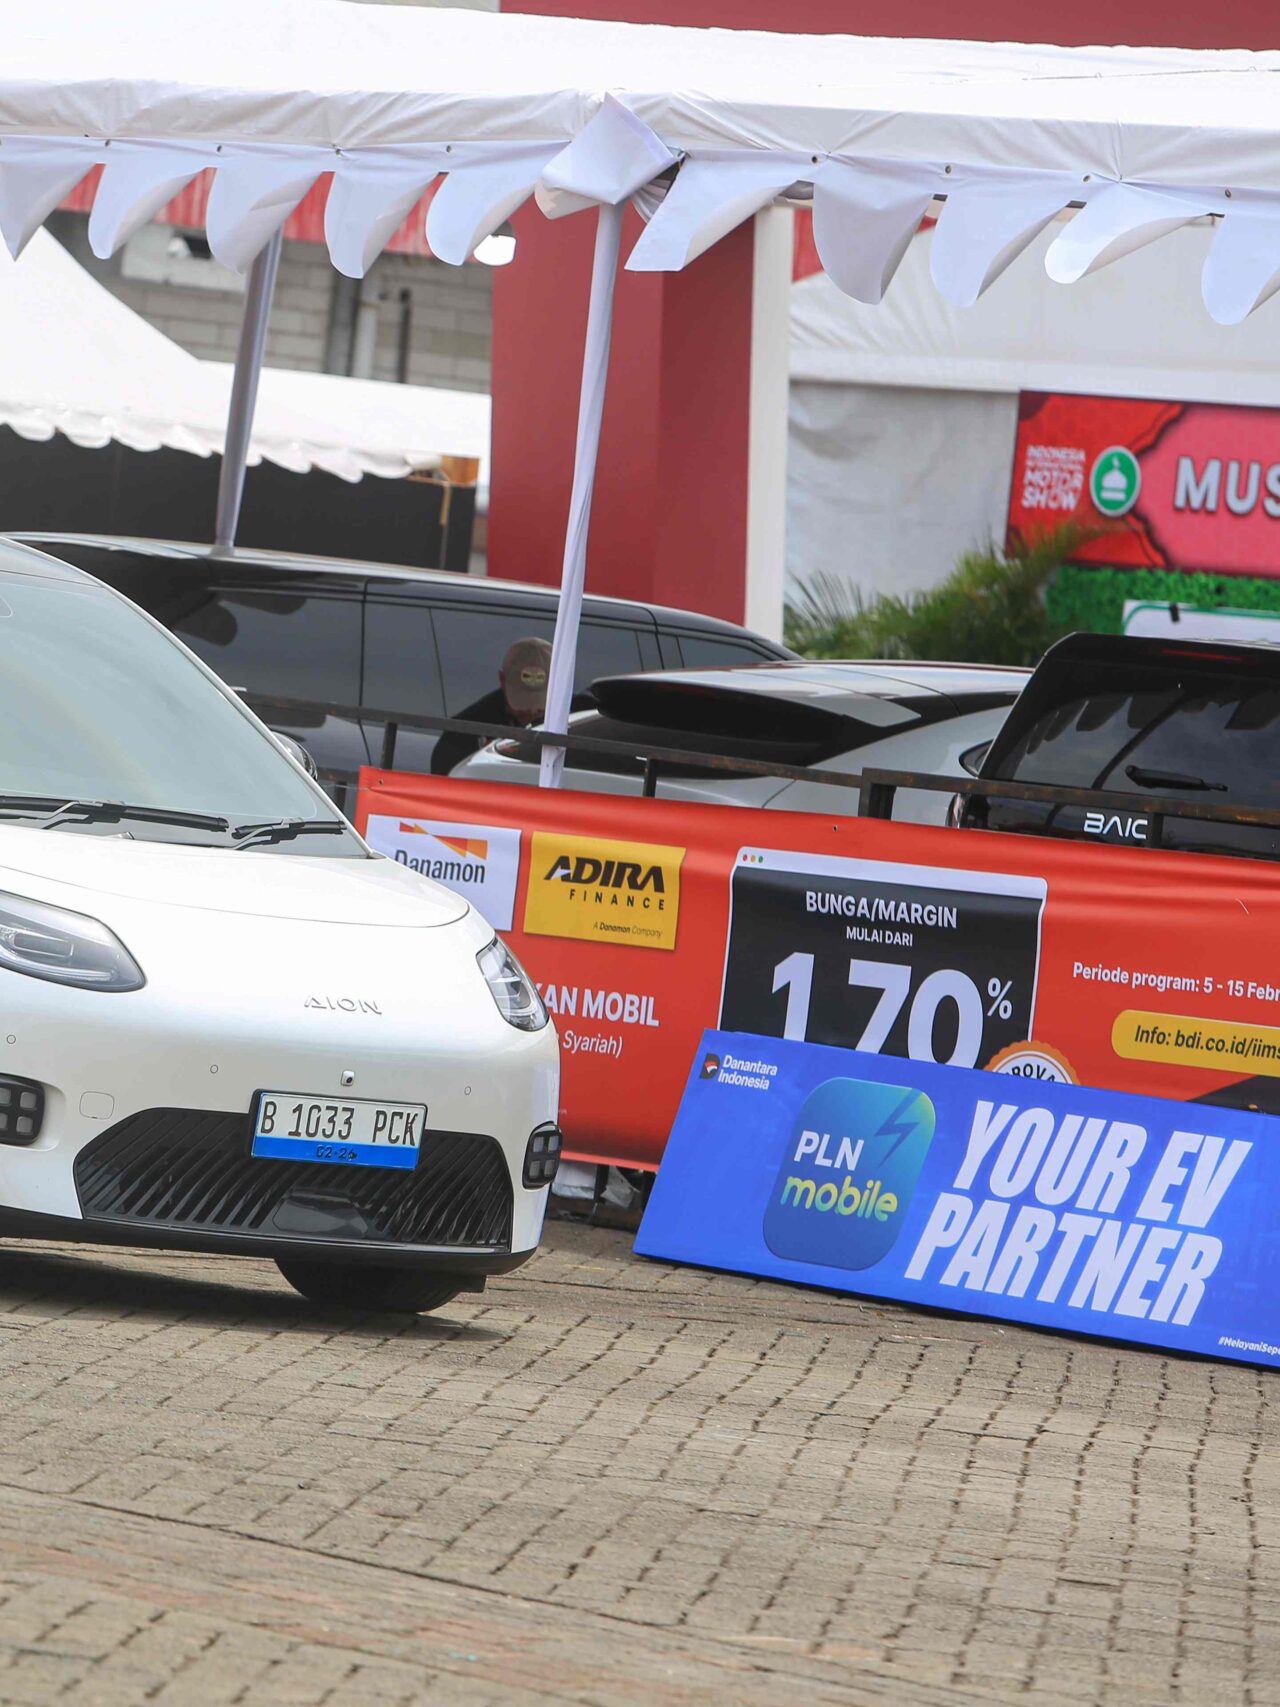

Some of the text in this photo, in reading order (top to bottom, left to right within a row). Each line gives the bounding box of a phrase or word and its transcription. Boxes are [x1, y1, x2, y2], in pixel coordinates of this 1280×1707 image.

[1084, 812, 1148, 839] BAIC
[395, 850, 485, 884] Danamon
[544, 855, 665, 893] ADIRA
[569, 888, 665, 911] FINANCE
[806, 891, 957, 928] BUNGA/MARGIN
[846, 926, 913, 947] MULAI DARI
[1073, 962, 1129, 984] Periode
[1132, 970, 1200, 993] program:
[1203, 976, 1213, 993] 5
[1227, 979, 1244, 997] 15
[304, 996, 382, 1015] AION
[535, 983, 660, 1027] AN MOBIL
[563, 1030, 623, 1059] Syariah)
[1134, 1024, 1171, 1047] Info:
[718, 1069, 770, 1090] Indonesia
[722, 1054, 778, 1077] Danantara
[260, 1101, 419, 1147] B 1033 PCK
[793, 1130, 865, 1171] PLN
[952, 1099, 1253, 1229] YOUR EV
[780, 1175, 898, 1222] mobile
[904, 1192, 1223, 1327] PARTNER
